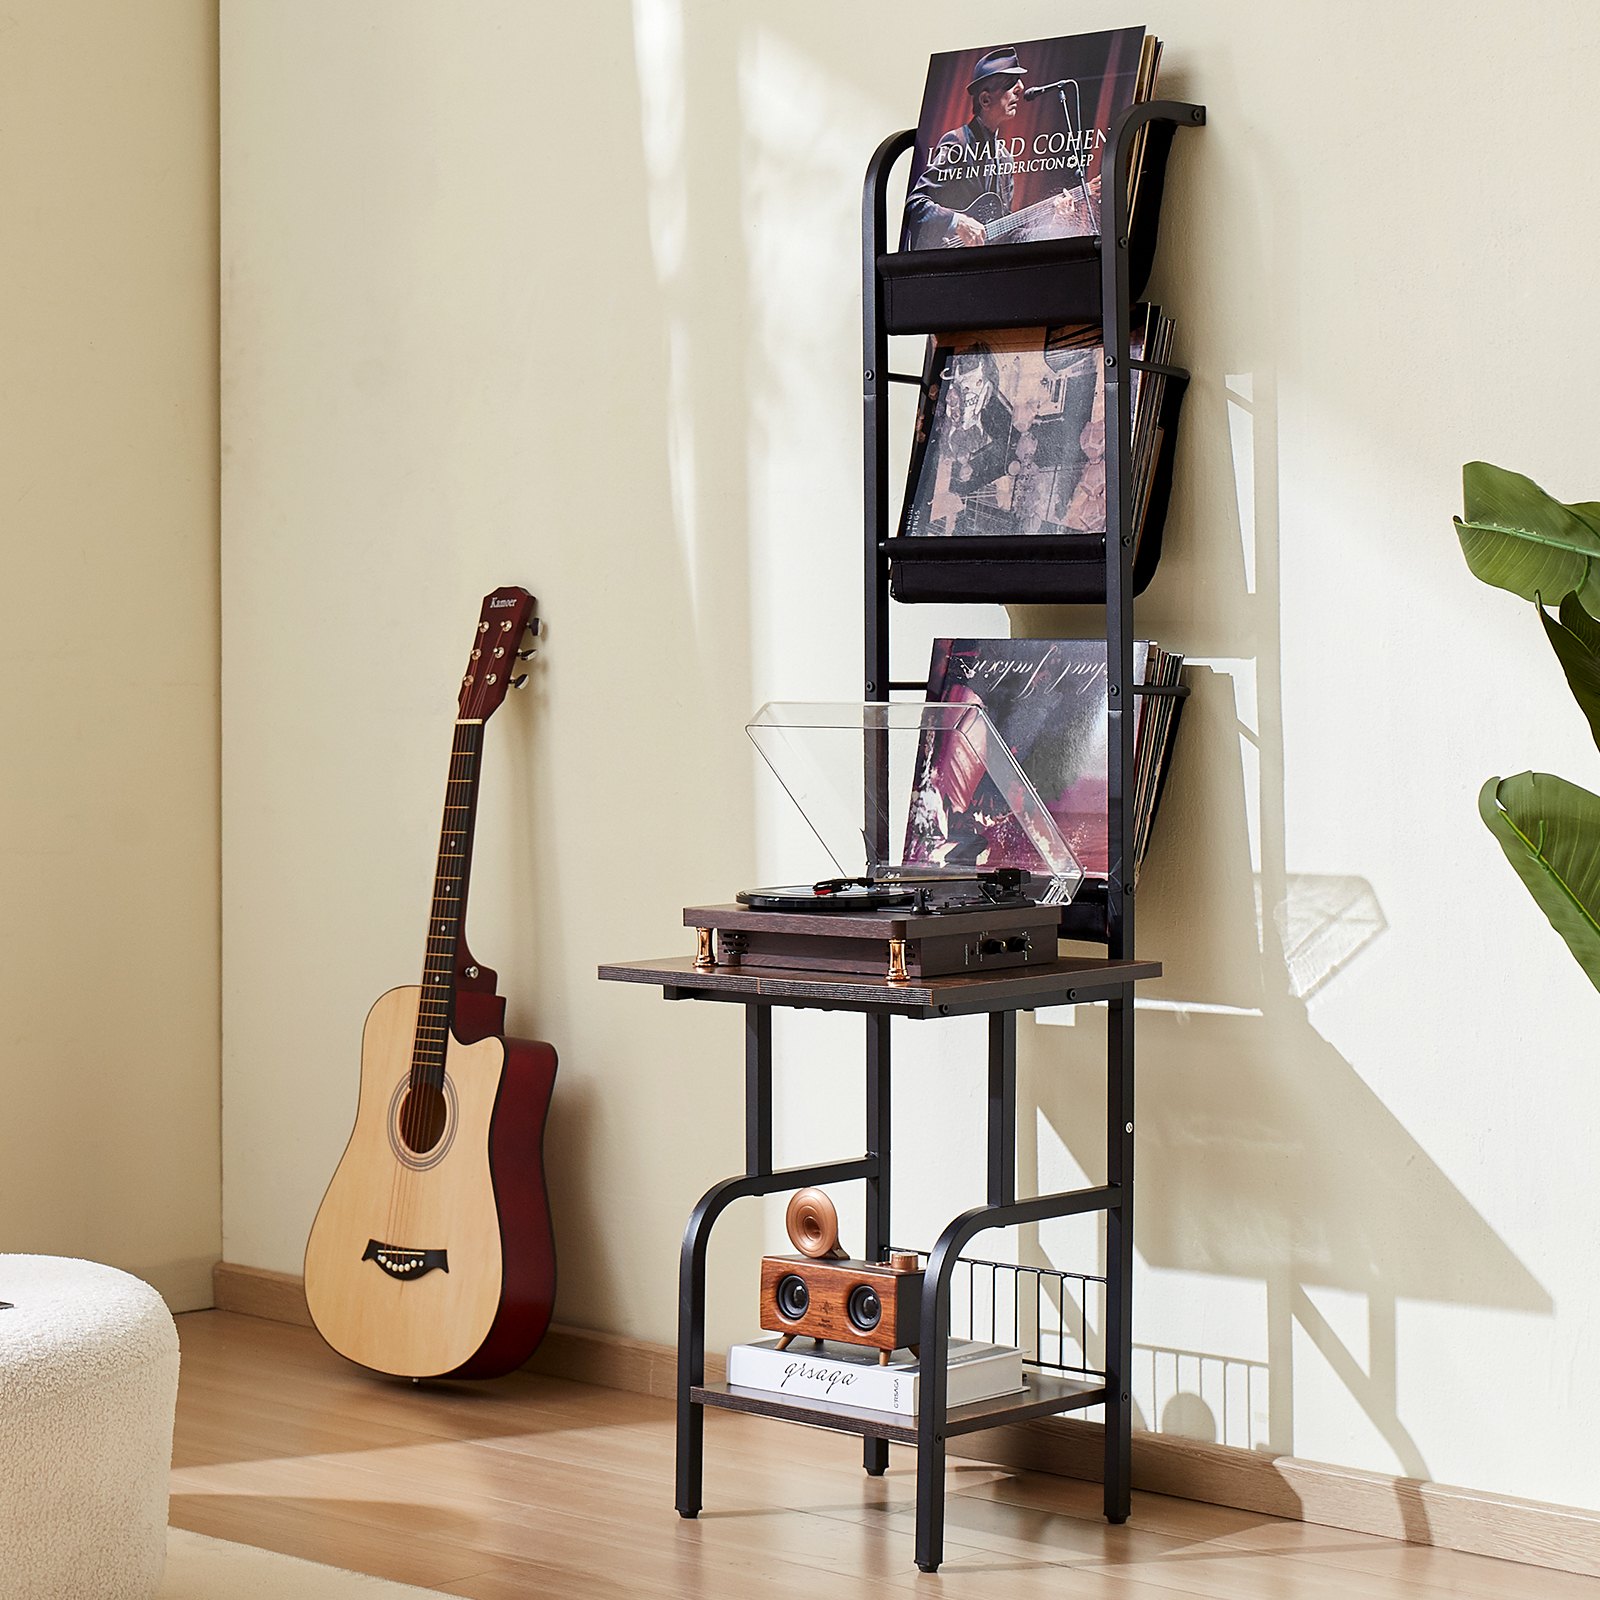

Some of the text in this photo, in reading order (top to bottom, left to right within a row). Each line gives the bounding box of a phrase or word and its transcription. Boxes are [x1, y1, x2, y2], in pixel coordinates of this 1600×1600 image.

[926, 137, 1025, 167] LEONARD
[937, 153, 1094, 182] LIVE IN FREDERICTON EP
[1044, 661, 1108, 696] hael
